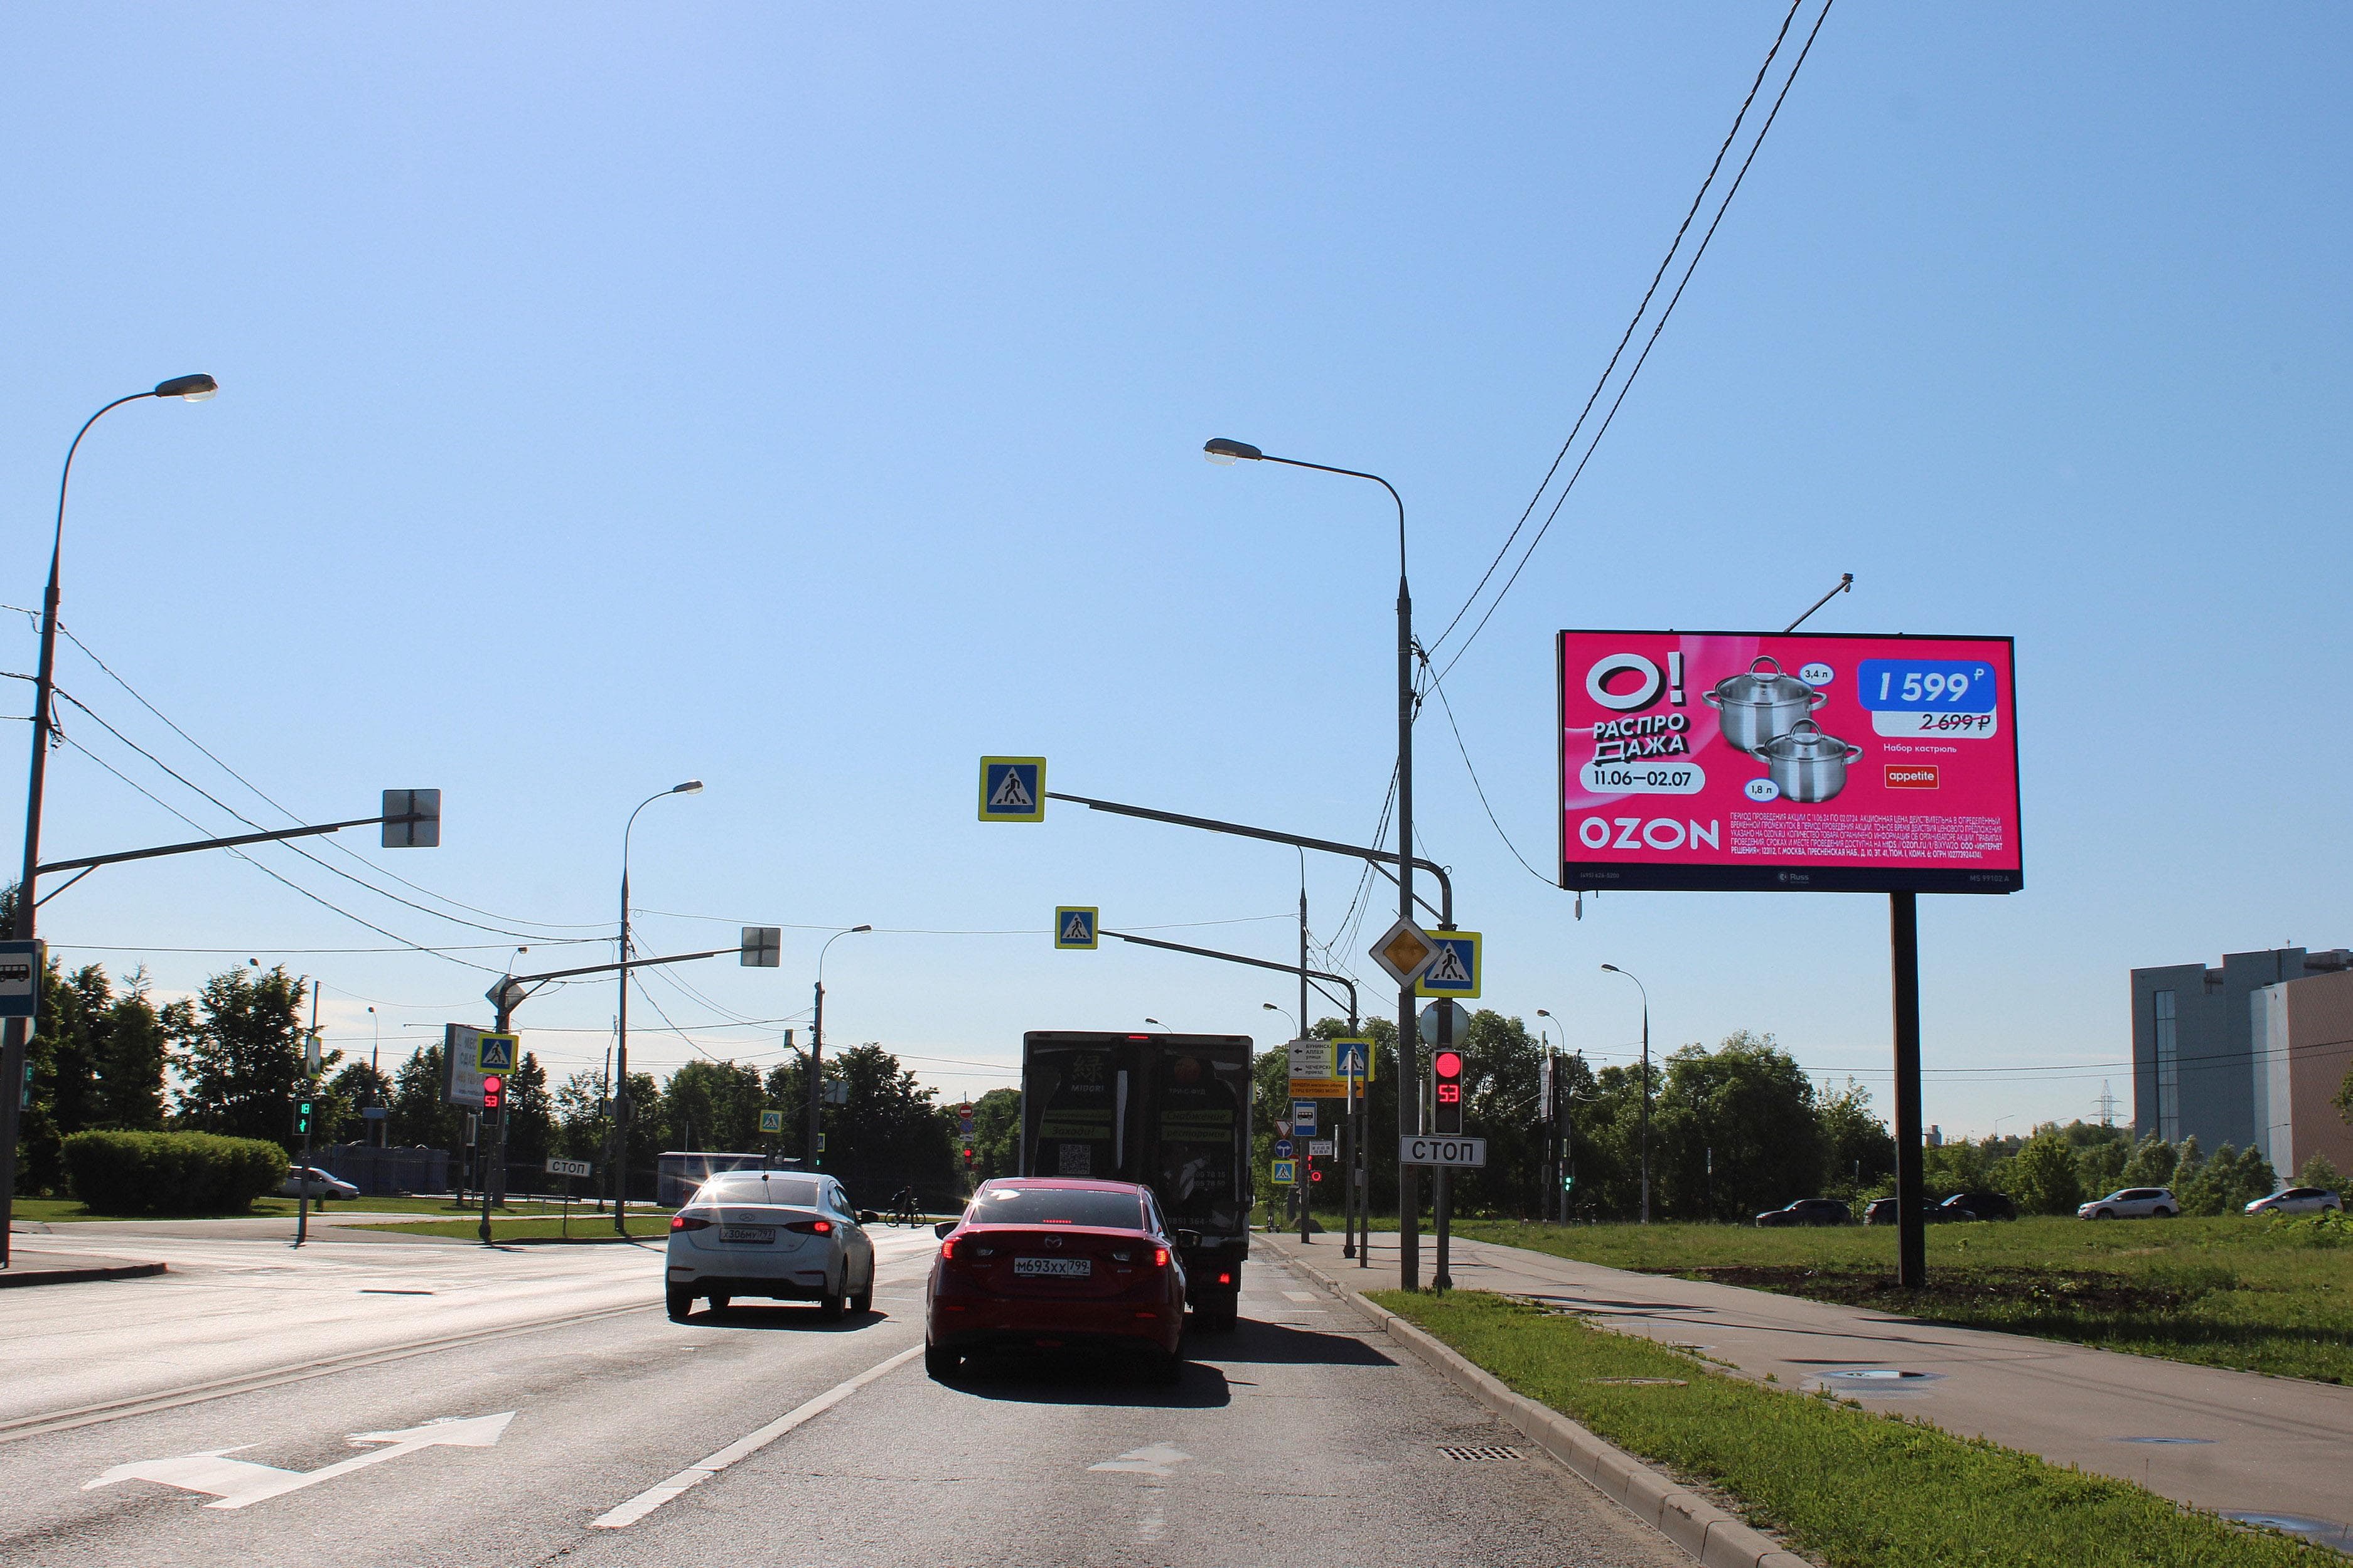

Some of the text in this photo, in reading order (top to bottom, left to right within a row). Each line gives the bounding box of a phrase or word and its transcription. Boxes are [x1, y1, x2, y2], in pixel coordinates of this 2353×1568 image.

[1804, 669, 1819, 679] 3,4
[1593, 713, 1685, 739] РАСПРО
[1592, 734, 1684, 764] ДАЖА
[1884, 743, 1912, 753] Набор
[1889, 771, 1934, 782] appetite
[1751, 786, 1762, 794] 1,8
[1730, 813, 1751, 821] ПЕРИОД
[1752, 813, 1786, 821] ПРОВЕДЕНИЯ
[1761, 821, 1796, 829] ПРОМЕЖУТОК
[1821, 823, 1854, 831] ПРОВЕДЕНИЯ
[1911, 824, 1937, 833] ДЕЙСТВИЯ
[1964, 824, 2002, 833] ПРЕДЛОЖЕНИЯ
[1579, 816, 1719, 851] OZON
[1808, 848, 1845, 856] ПРЕСНЕНСКАЯ
[1438, 1084, 1459, 1102] 53
[485, 1096, 498, 1107] 53
[301, 1104, 309, 1114] 18
[1167, 1111, 1226, 1121] Снабжение
[1052, 1126, 1095, 1136] Заходи!
[1167, 1129, 1225, 1139] ресторанов
[1412, 1141, 1474, 1161] СТОП
[553, 1161, 585, 1175] СТОП
